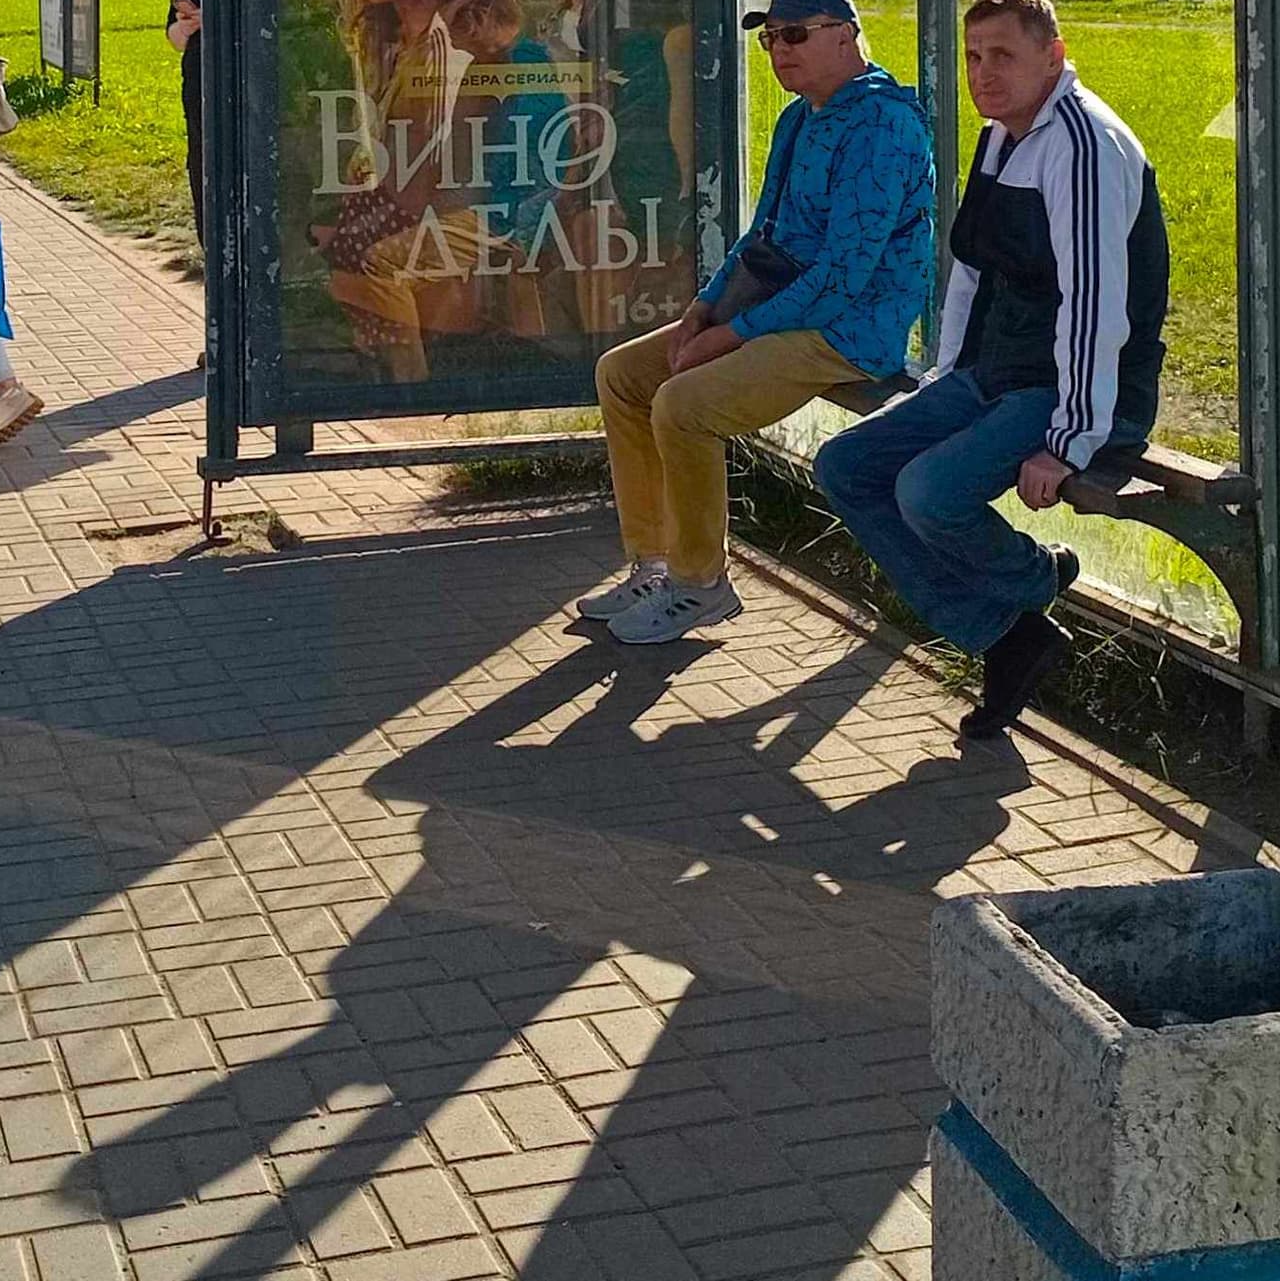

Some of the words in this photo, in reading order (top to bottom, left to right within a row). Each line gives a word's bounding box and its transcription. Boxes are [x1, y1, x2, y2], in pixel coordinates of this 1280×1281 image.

[503, 71, 583, 86] СЕРИАЛА
[394, 196, 667, 282] ДЕЛЫ
[608, 292, 681, 325] 16+
